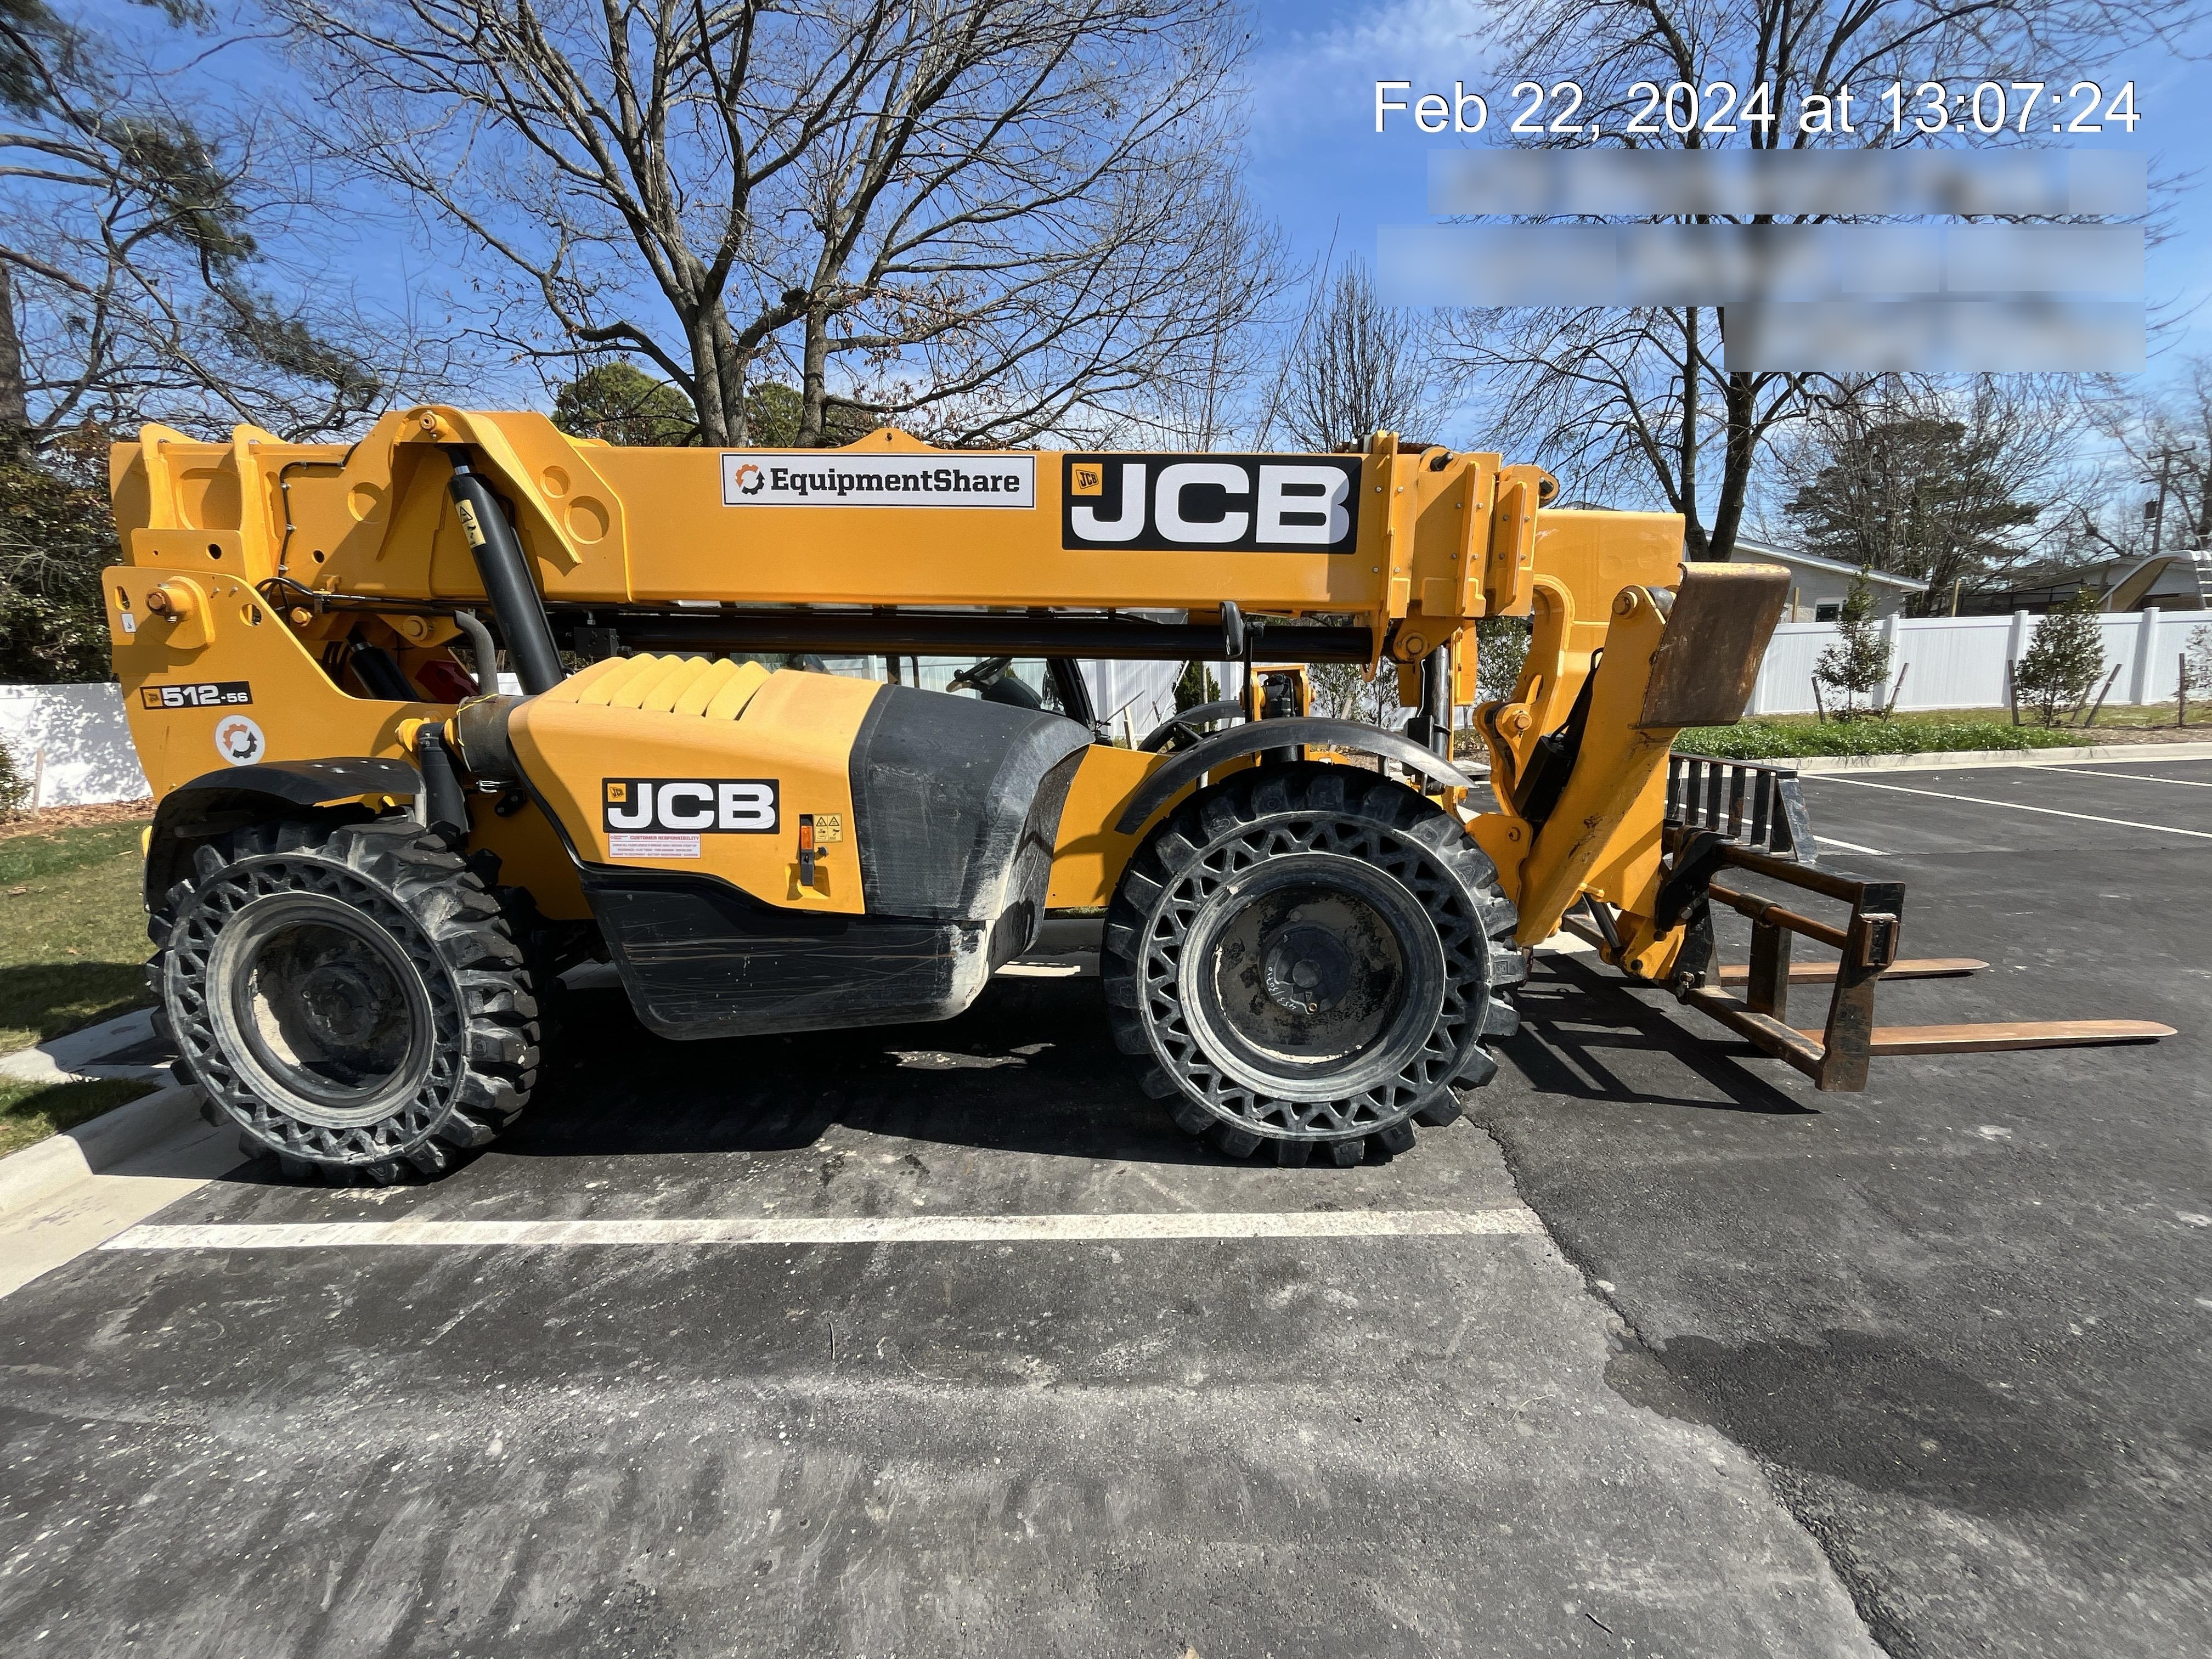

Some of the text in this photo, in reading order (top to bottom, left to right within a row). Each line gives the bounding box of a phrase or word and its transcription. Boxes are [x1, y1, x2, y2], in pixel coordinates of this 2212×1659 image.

[770, 467, 1020, 496] EquipmentShare
[1079, 471, 1097, 488] JCB
[1071, 463, 1350, 544] JCB
[607, 783, 776, 829] JCB
